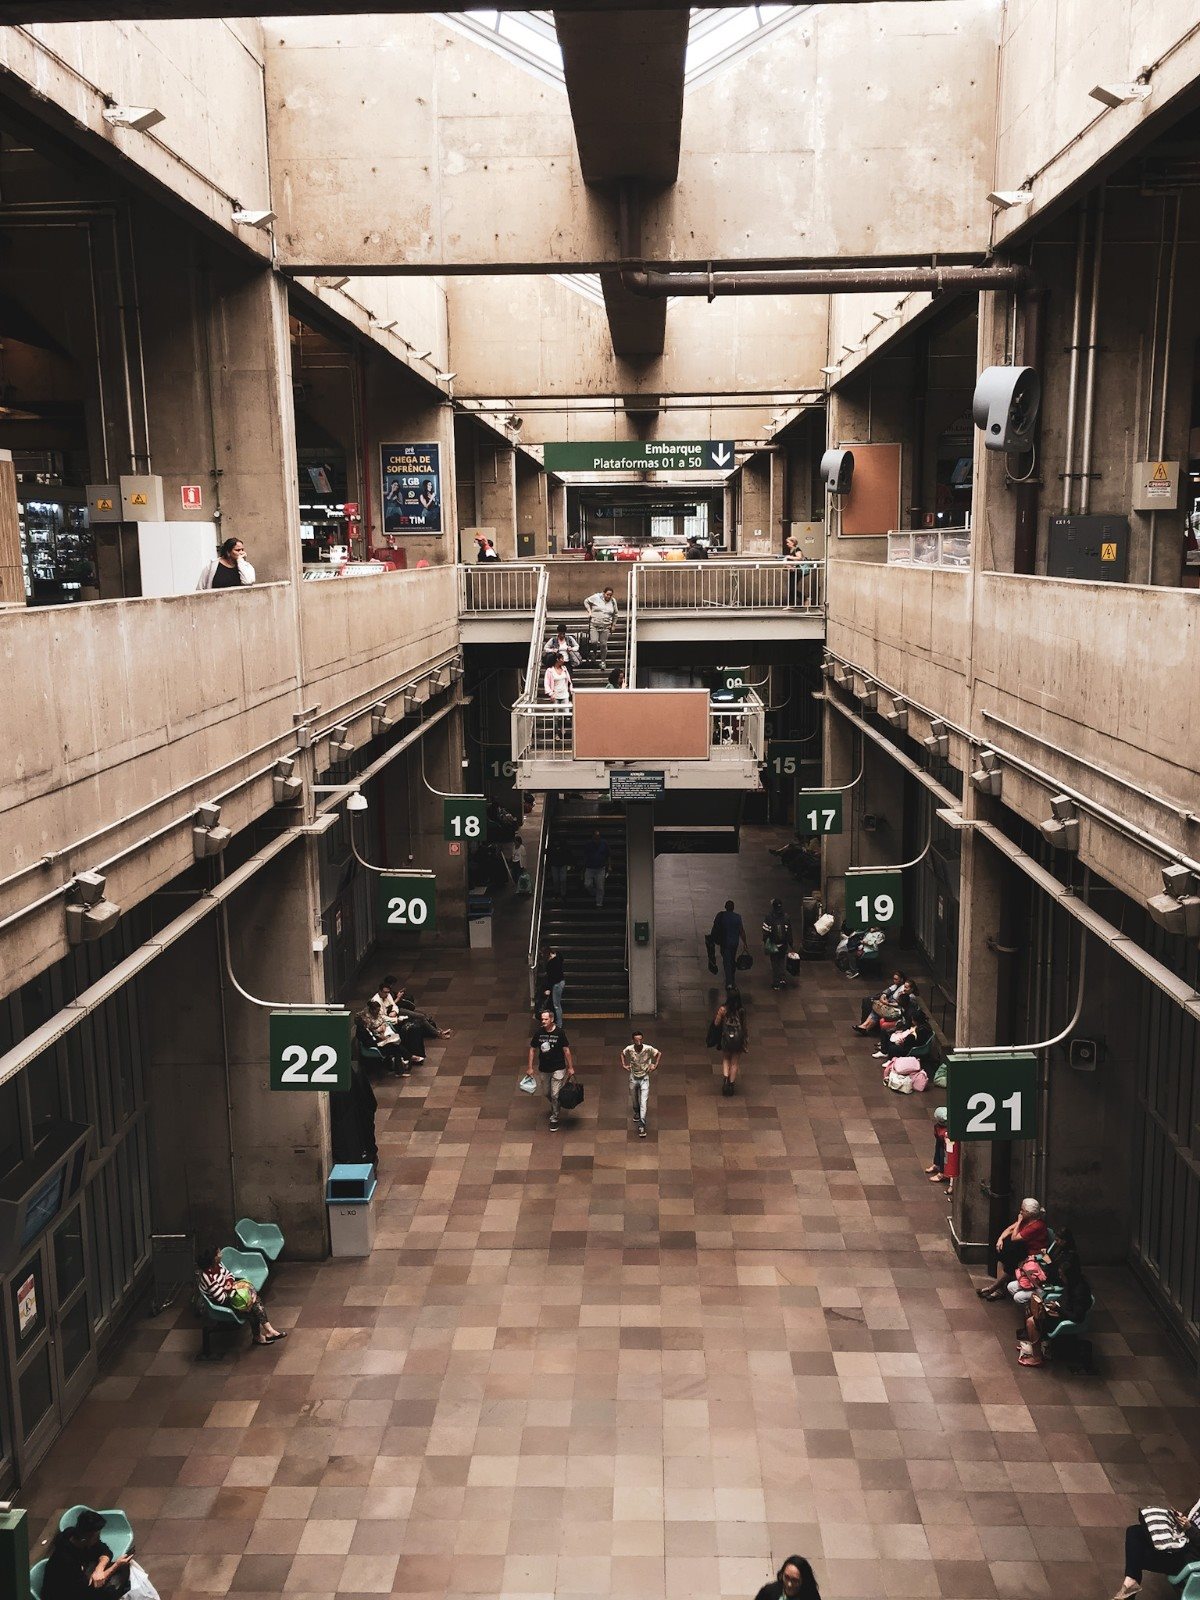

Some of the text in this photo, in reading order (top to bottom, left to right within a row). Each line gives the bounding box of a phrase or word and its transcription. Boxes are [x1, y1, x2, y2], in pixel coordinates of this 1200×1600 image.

[645, 443, 702, 455] Embarque
[387, 464, 434, 472] SOFRÊNCIA.
[390, 455, 430, 463] CHEGA DE
[593, 457, 702, 469] Plataformas 01 a 50
[410, 516, 425, 524] TIM
[491, 760, 515, 778] 16
[772, 757, 796, 774] 15
[450, 815, 480, 837] 18
[806, 809, 836, 831] 17
[387, 896, 427, 925] 20
[855, 894, 894, 923] 19
[281, 1044, 338, 1083] 22
[965, 1091, 1022, 1133] 21
